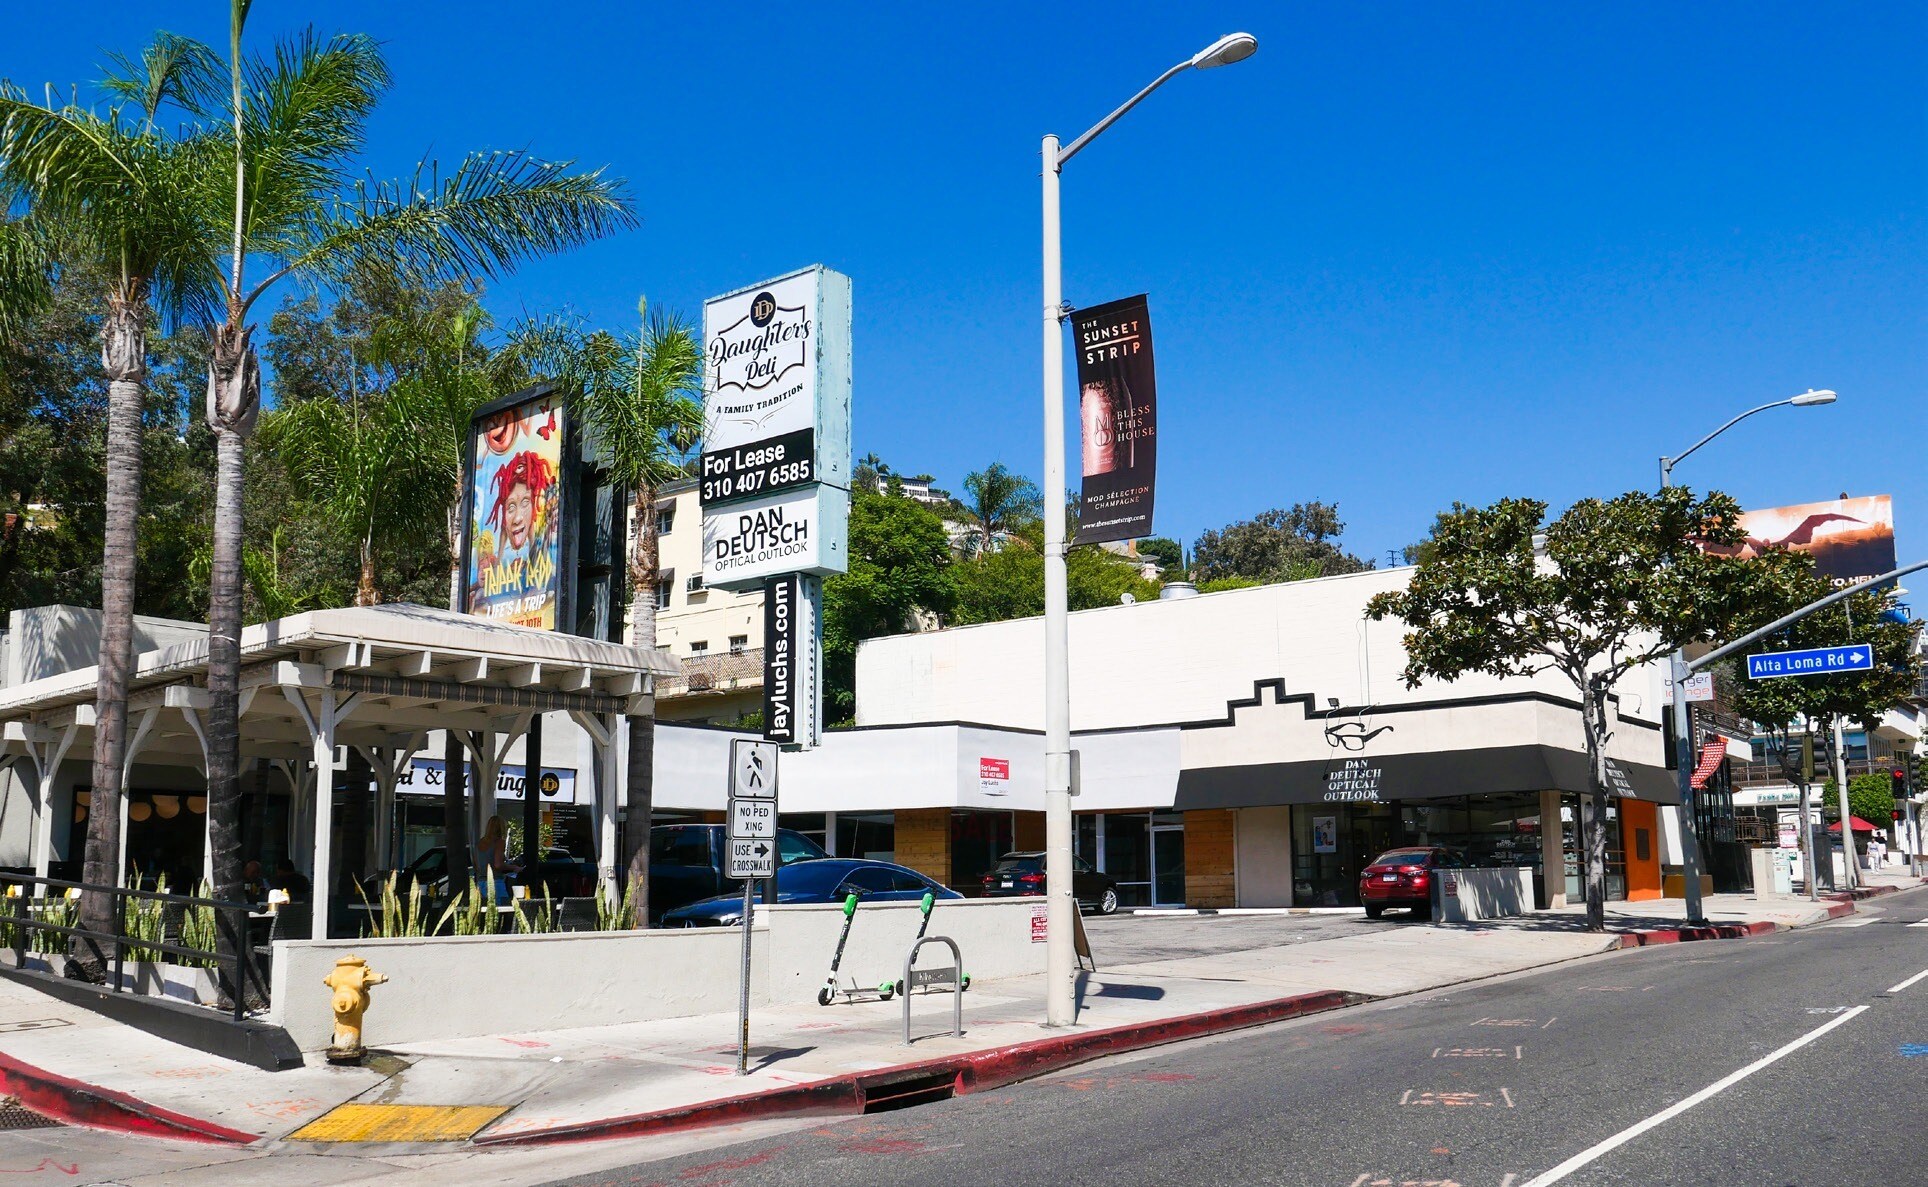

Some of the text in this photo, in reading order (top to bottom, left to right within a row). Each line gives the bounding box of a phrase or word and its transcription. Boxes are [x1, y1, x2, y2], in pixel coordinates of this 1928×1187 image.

[1082, 320, 1097, 330] THE
[1083, 321, 1138, 344] SUNSET
[1086, 341, 1141, 365] STRIP
[745, 356, 777, 381] Deli
[716, 383, 804, 414] A FAMILY TRADITION
[1117, 404, 1151, 420] BLESS
[1117, 417, 1143, 431] THIS
[1117, 426, 1155, 442] HOUSE
[704, 444, 785, 477] For Lease
[704, 459, 810, 500] 310 407 6585
[1087, 494, 1104, 504] MOD
[1094, 496, 1140, 510] CHAMPAGNE
[739, 506, 783, 536] DAN
[716, 519, 808, 560] DEUTSCH
[715, 541, 808, 572] OPTICAL OUTLOOK
[514, 598, 522, 614] A
[524, 593, 547, 612] TRIP
[769, 581, 791, 737] jayluchs.com
[1754, 653, 1845, 673] Alta Loma Rd
[1345, 759, 1368, 769] DAN
[1329, 768, 1381, 780] DEUTSCH
[1328, 779, 1378, 791] OPTICAL
[1323, 789, 1379, 801] OUTLOOK
[740, 807, 769, 818] NO PED
[745, 821, 763, 832] XING
[735, 844, 751, 856] USE
[732, 860, 771, 872] CROSSWALK
